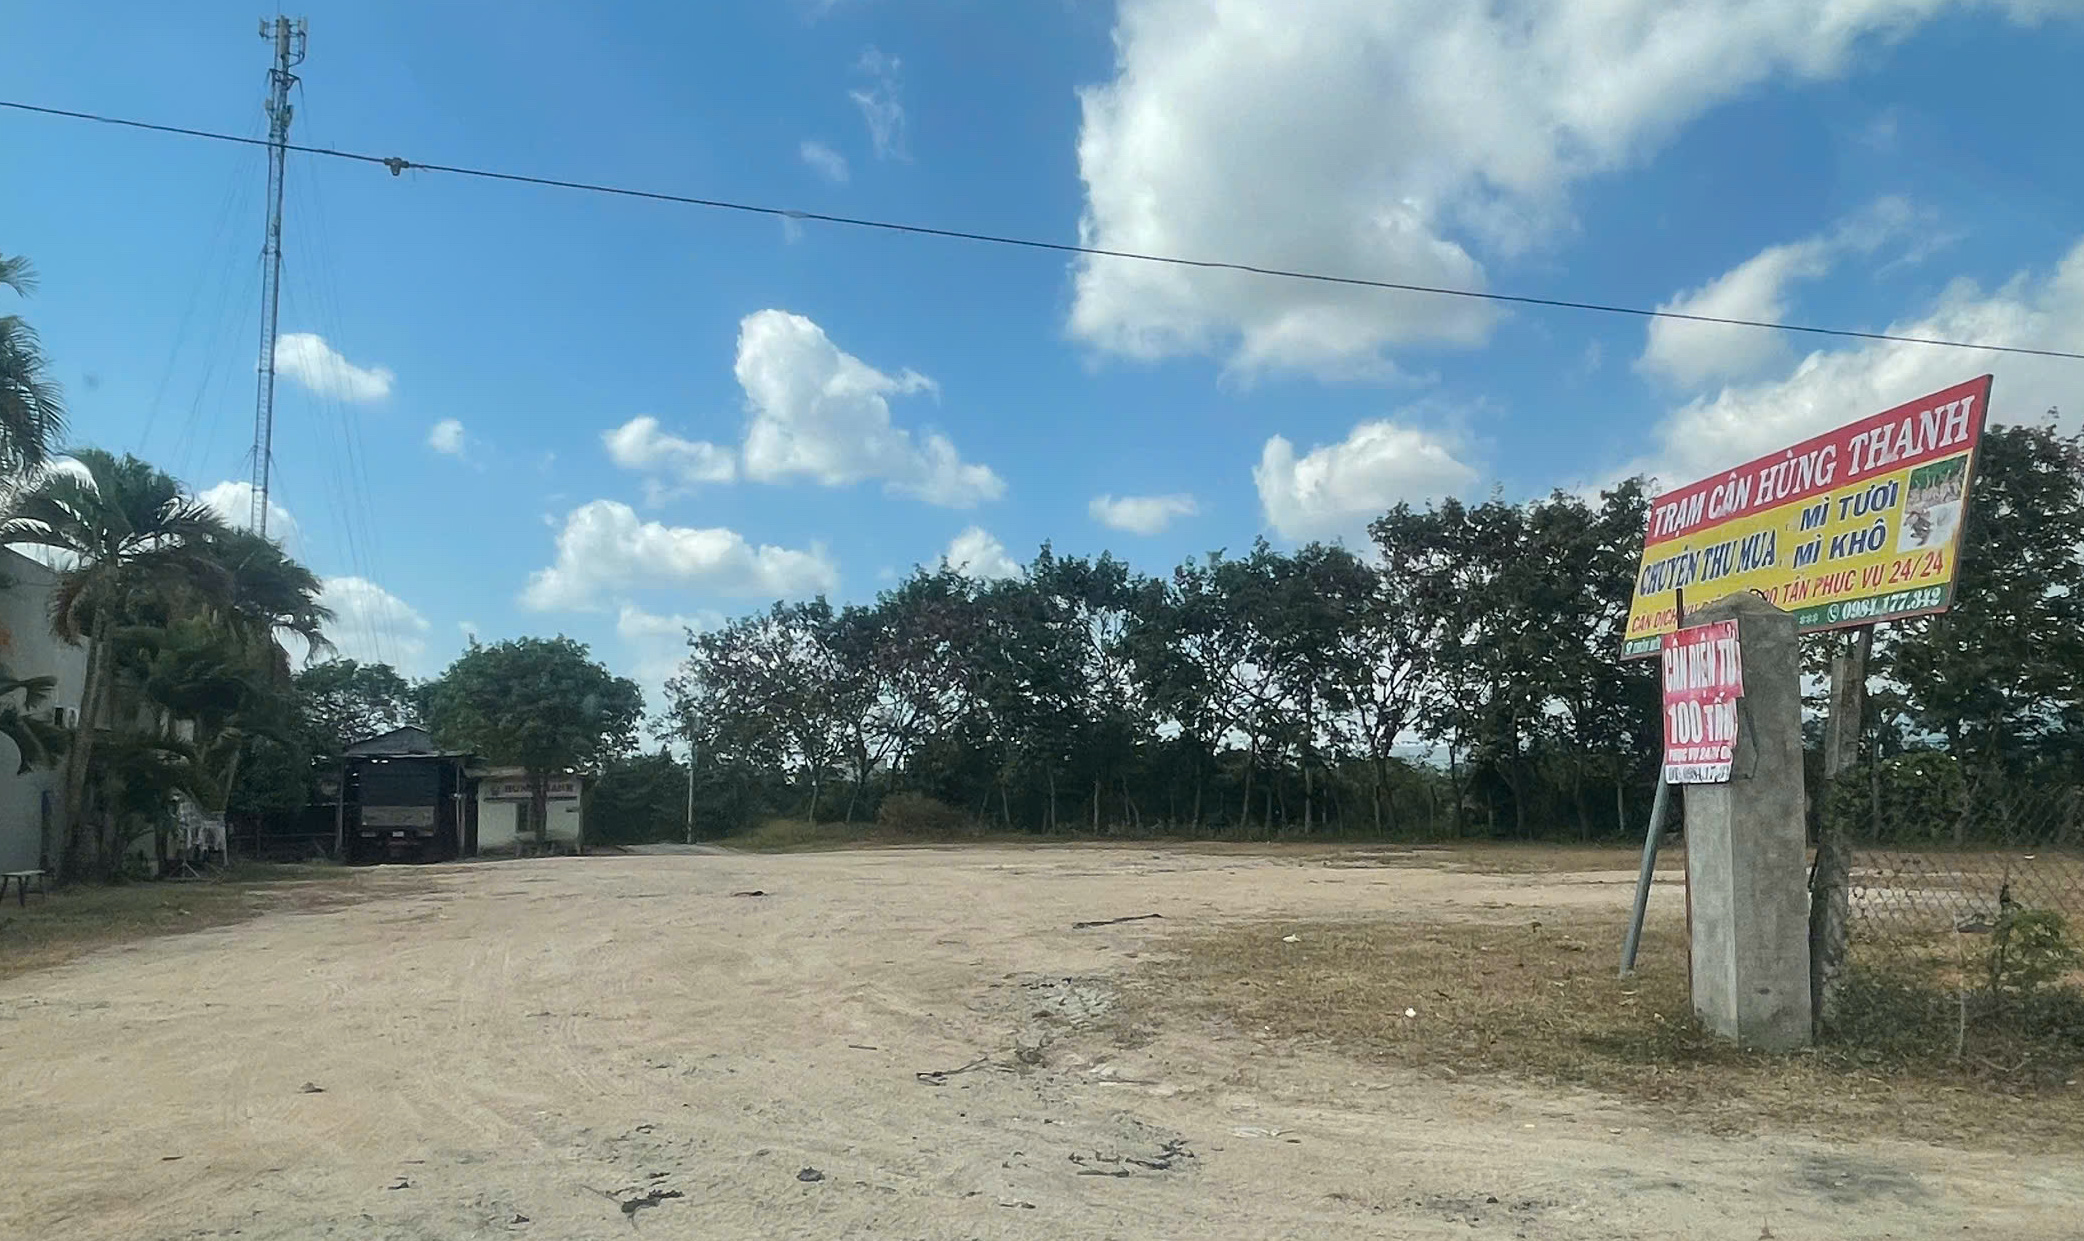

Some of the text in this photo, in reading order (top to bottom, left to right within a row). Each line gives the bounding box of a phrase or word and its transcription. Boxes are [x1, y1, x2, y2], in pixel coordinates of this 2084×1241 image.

[1653, 395, 1975, 537] TRẠM CÂN HÙNG THANH
[1800, 480, 1899, 531] MÌ TƯƠI
[1640, 530, 1776, 596] CHUYÊN THU MUA
[1792, 518, 1886, 569] MÌ KHÔ
[1813, 569, 1857, 598] PHỤC
[1862, 563, 1886, 592] VỤ
[1888, 549, 1944, 584] 24/24
[1668, 700, 1703, 744] 100
